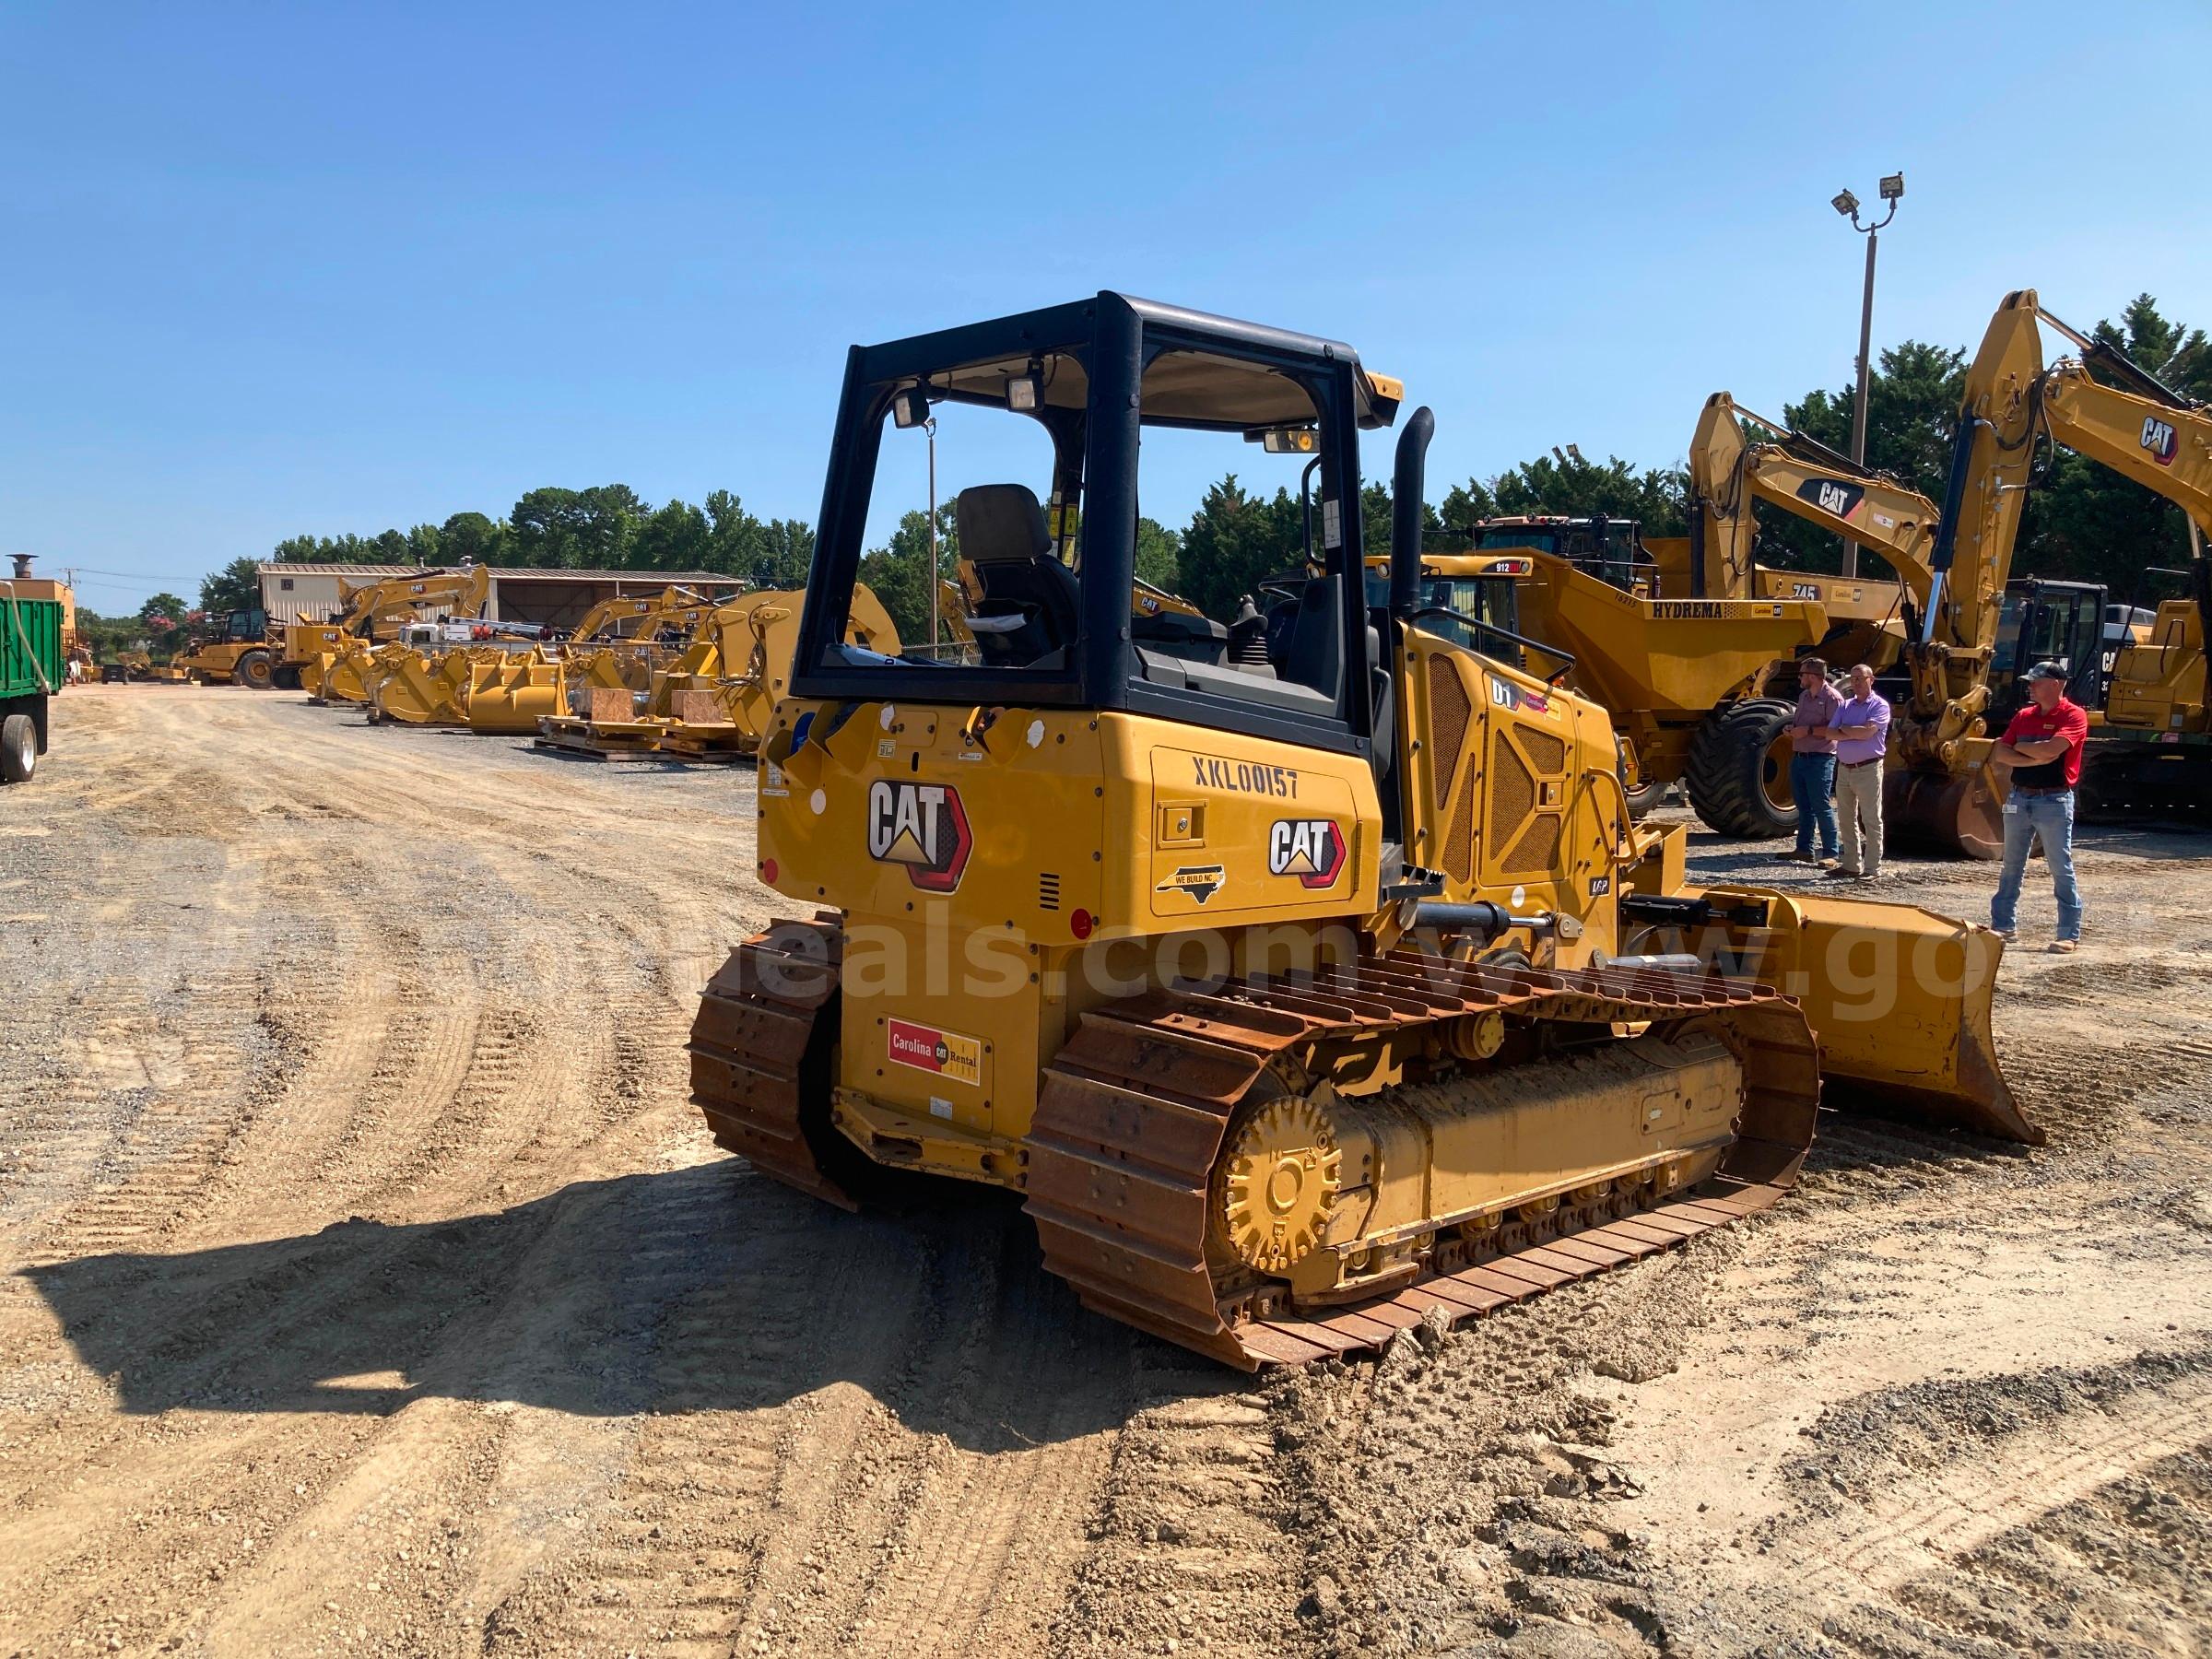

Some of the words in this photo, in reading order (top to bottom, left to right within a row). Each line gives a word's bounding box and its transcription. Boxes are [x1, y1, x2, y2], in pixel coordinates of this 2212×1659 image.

[2141, 417, 2173, 455] CAT
[1818, 482, 1848, 514] CAT
[1496, 563, 1510, 572] 912
[634, 604, 647, 613] CAT
[1141, 597, 1159, 611] CAT
[1653, 602, 1723, 618] HYDREMA
[686, 612, 698, 621] CAT
[323, 632, 336, 641] CAT
[2102, 652, 2116, 672] CA
[1491, 677, 1512, 709] D1
[1192, 756, 1298, 799] XKL00157
[869, 782, 945, 865] CAT
[1270, 821, 1329, 874] CAT
[1175, 876, 1185, 885] WE
[1186, 875, 1203, 884] BUILD
[1204, 874, 1213, 882] NC
[1592, 879, 1608, 893] LGP
[892, 1033, 932, 1057] Carolina
[935, 1046, 947, 1059] CAT
[949, 1051, 977, 1067] Rental
